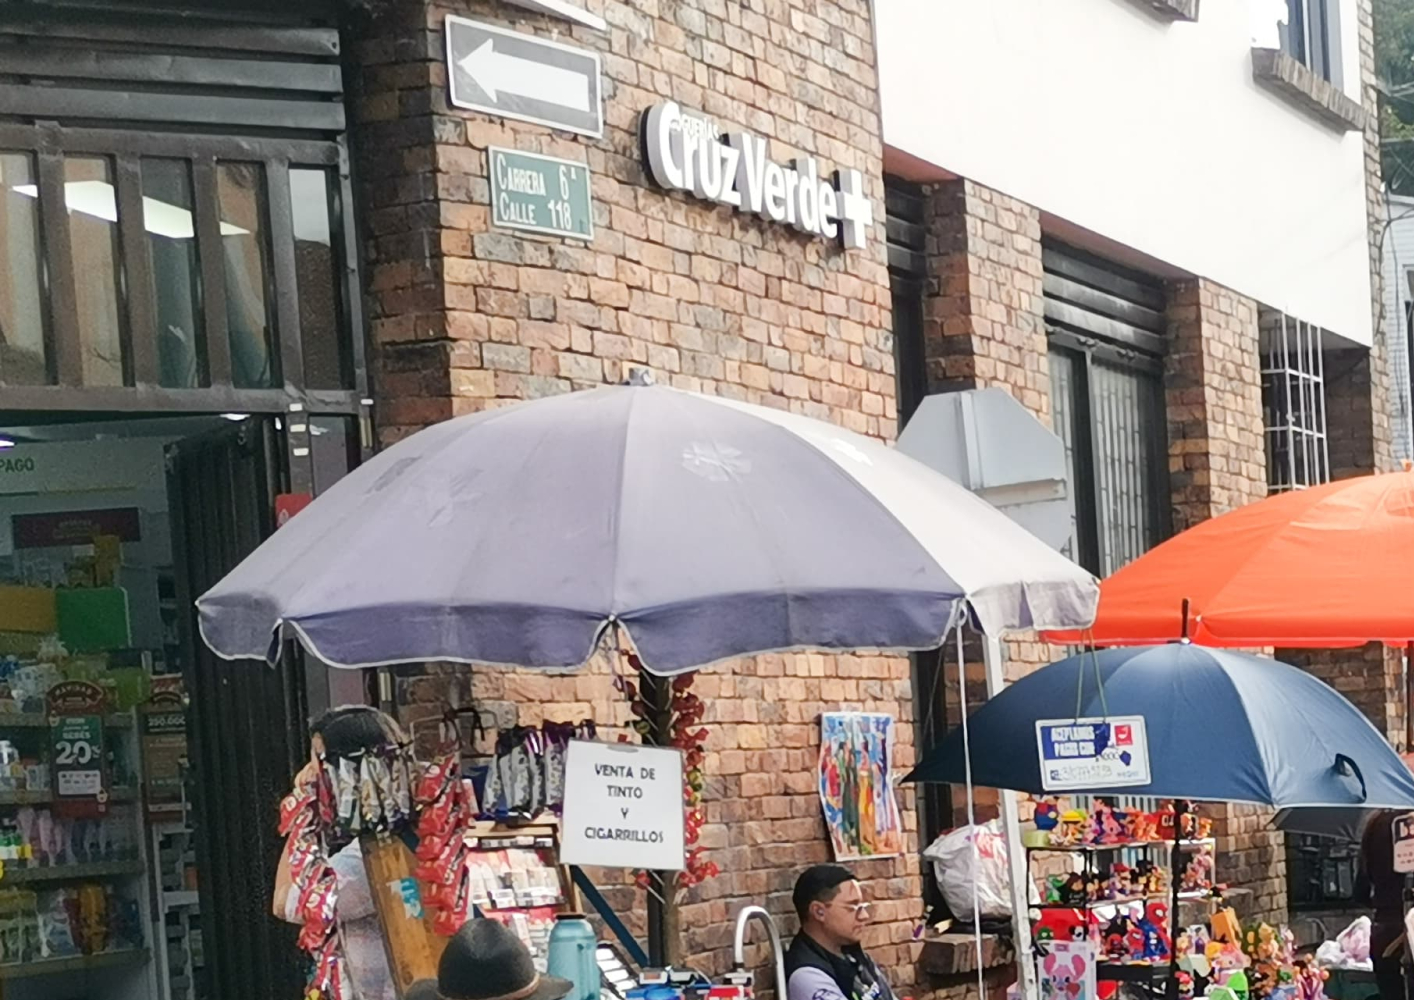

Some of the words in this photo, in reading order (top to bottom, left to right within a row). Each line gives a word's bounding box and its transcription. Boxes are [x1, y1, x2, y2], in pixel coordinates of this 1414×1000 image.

[496, 153, 547, 197] CARRERA
[658, 101, 742, 206] Cruz
[742, 132, 838, 238] Verde
[500, 191, 537, 226] CALLE
[547, 199, 573, 231] 118
[595, 763, 634, 779] VENTA
[640, 767, 656, 780] DE
[606, 784, 643, 799] TINTO
[620, 807, 629, 820] Y
[584, 826, 664, 844] CIGARRILLOS
